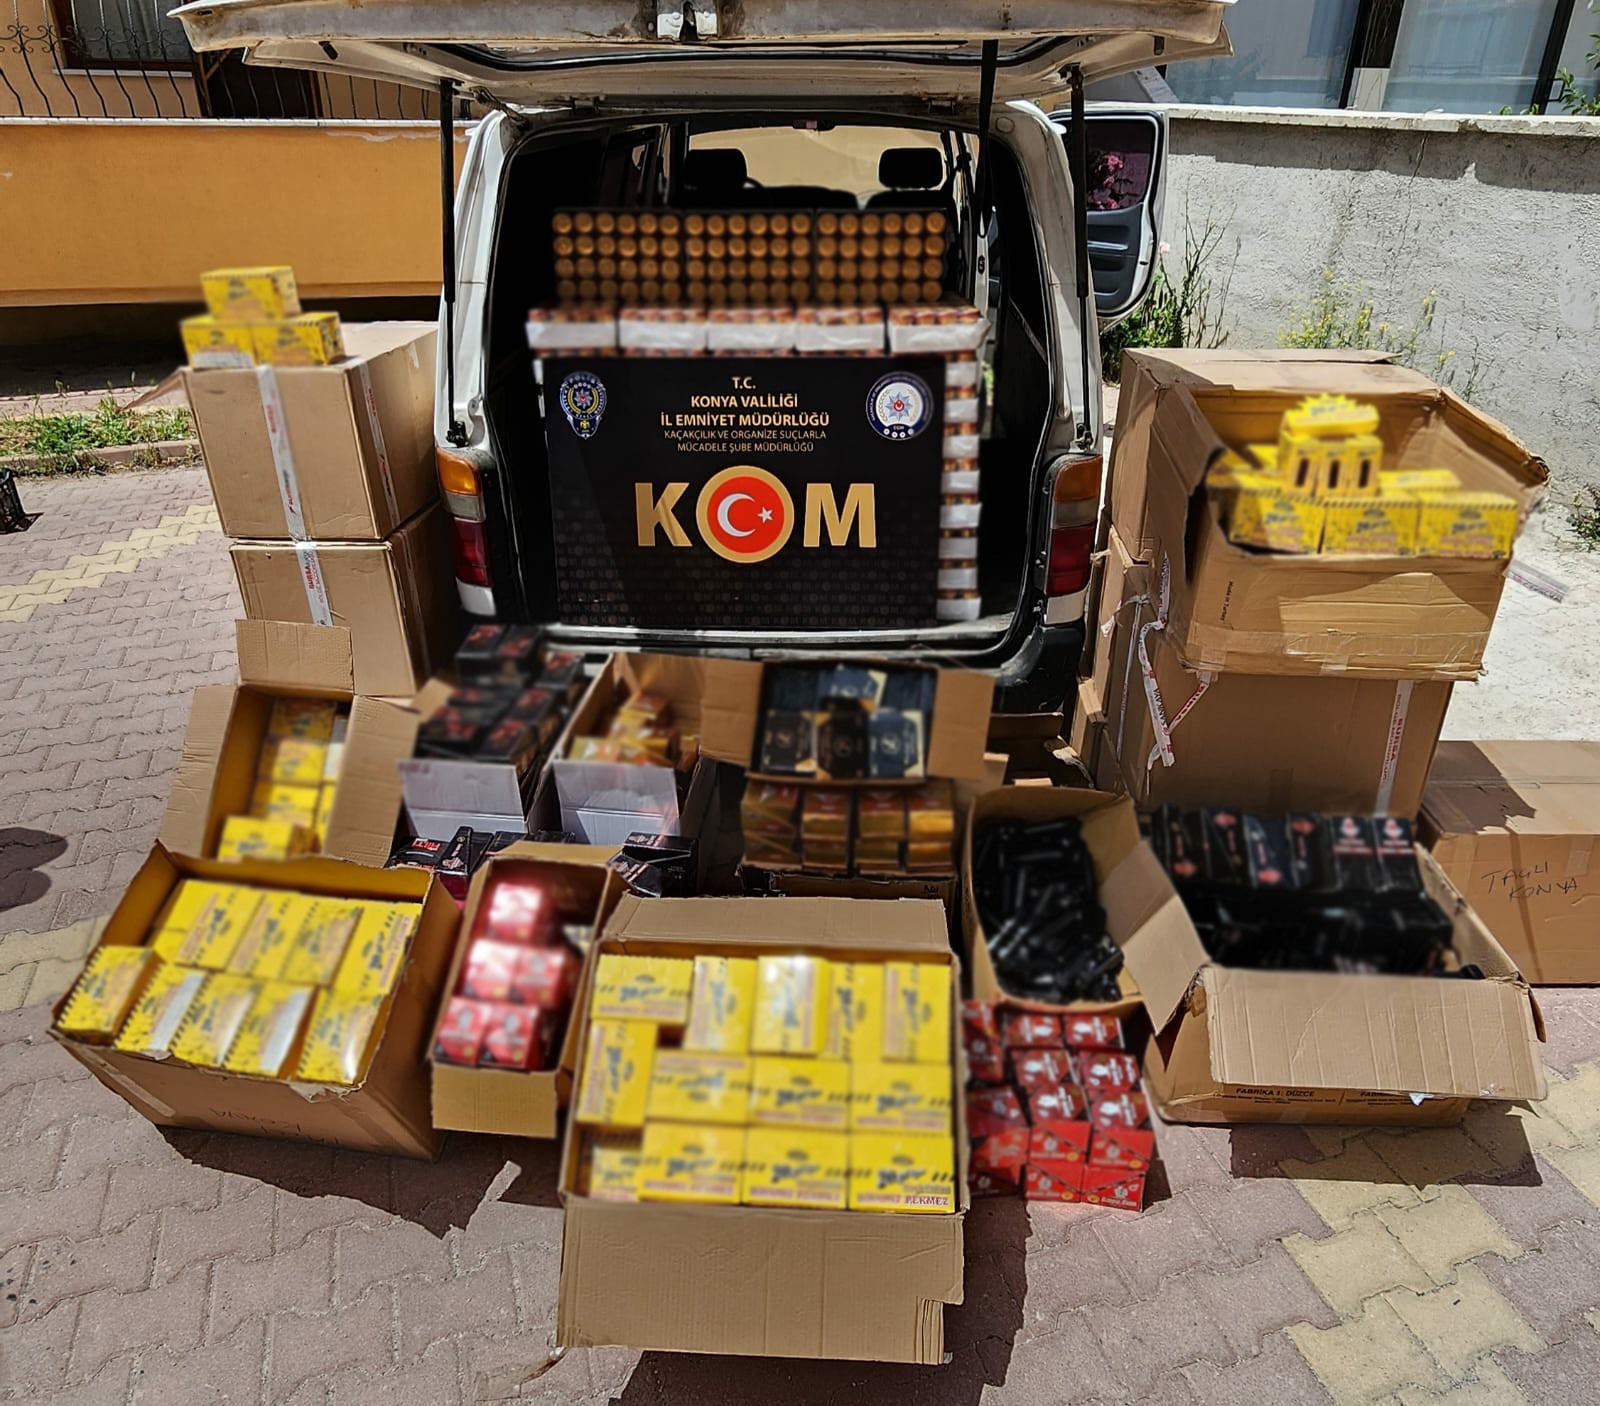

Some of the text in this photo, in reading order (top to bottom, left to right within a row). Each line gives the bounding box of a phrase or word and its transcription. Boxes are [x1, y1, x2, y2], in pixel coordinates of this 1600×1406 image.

[732, 377, 757, 389] T.C.
[691, 393, 798, 408] KONYA VALİLİĞİ
[661, 412, 830, 426] İL EMNİYET MÜDÜRLÜĞÜ
[664, 429, 827, 441] KAÇAKÇILIK VE ORGANİZE SUÇLARLA
[677, 442, 814, 454] MÜCADELE ŞUBE MÜDÜRLÜĞÜ
